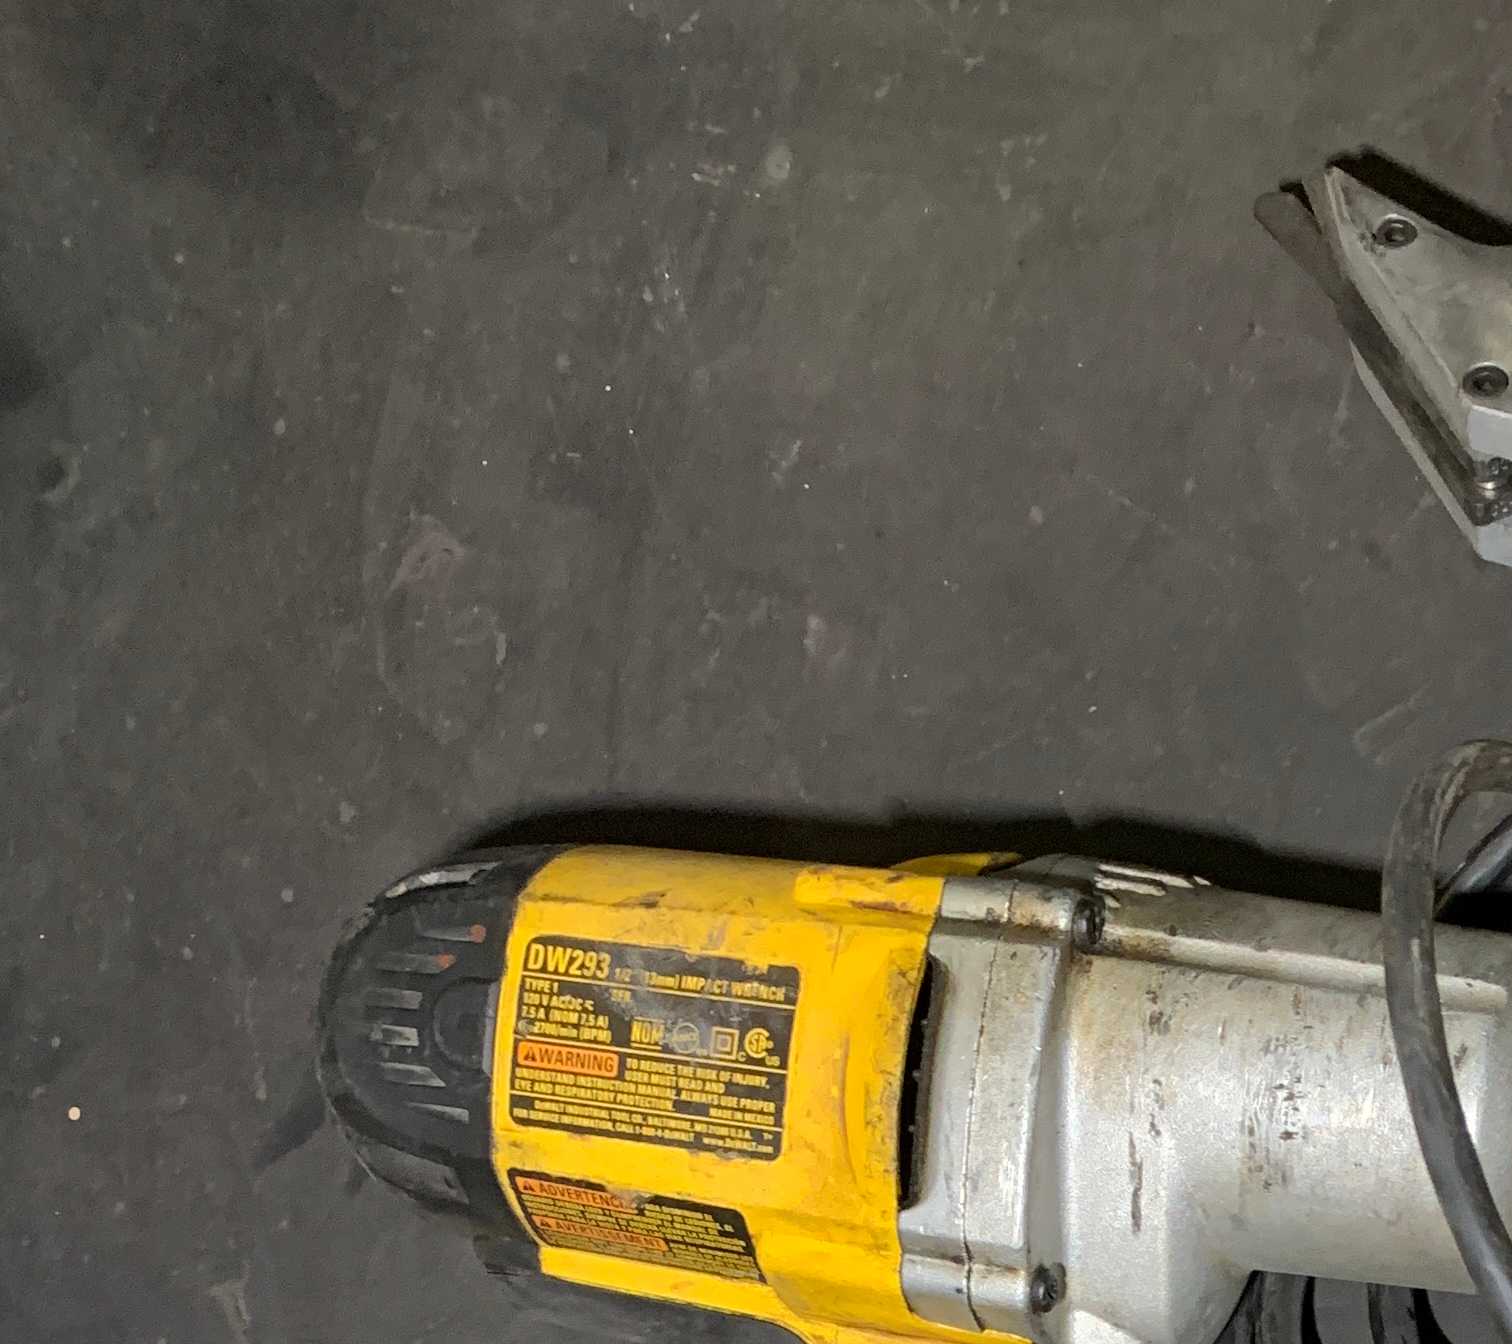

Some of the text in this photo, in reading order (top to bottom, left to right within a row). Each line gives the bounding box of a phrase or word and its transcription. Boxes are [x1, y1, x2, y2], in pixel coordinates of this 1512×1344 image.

[524, 977, 552, 993] TYPE
[526, 942, 612, 979] DW293
[679, 973, 730, 996] IMPACT
[729, 979, 786, 1003] WRENCH
[536, 1006, 547, 1020] A
[630, 1020, 665, 1045] NOM
[536, 1046, 615, 1073] WARNING
[541, 1183, 629, 1208] ADVERTENCI
